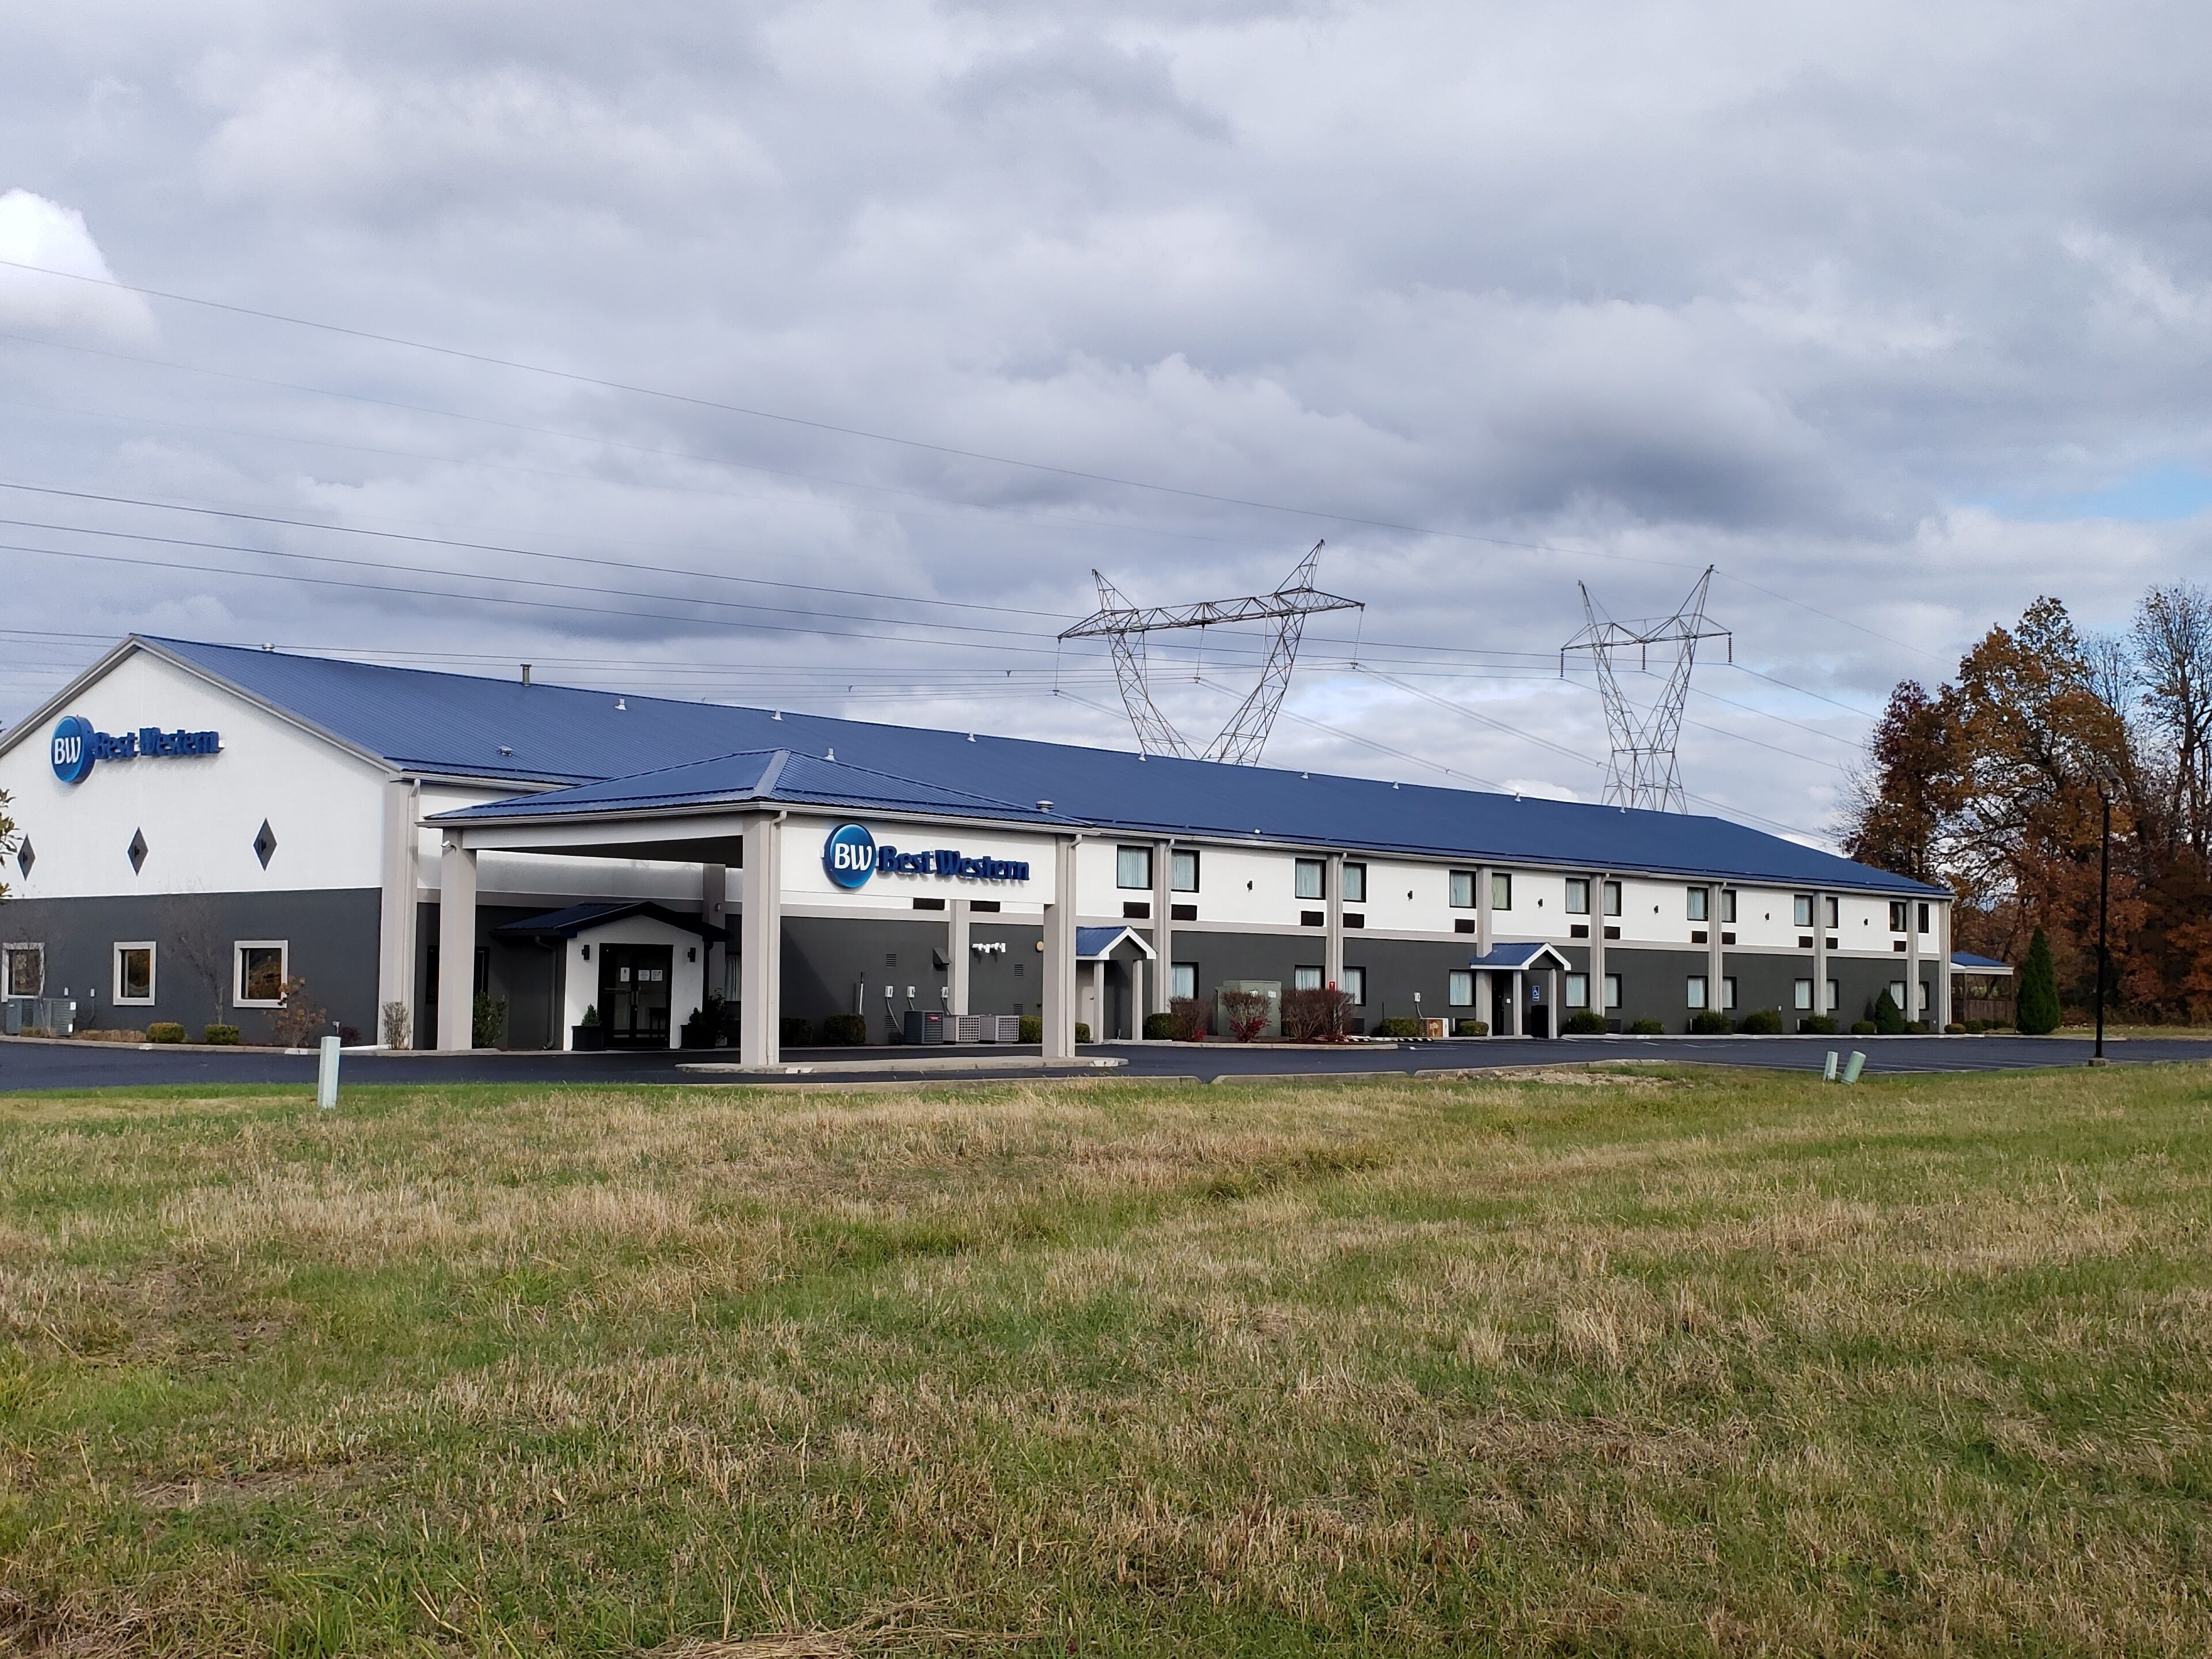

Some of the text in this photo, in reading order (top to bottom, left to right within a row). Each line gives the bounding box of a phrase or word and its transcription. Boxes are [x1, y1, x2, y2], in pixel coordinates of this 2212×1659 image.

[54, 736, 81, 765] BW
[94, 727, 220, 760] Best Western
[834, 843, 873, 872] BW
[878, 845, 1030, 881] Best Western
